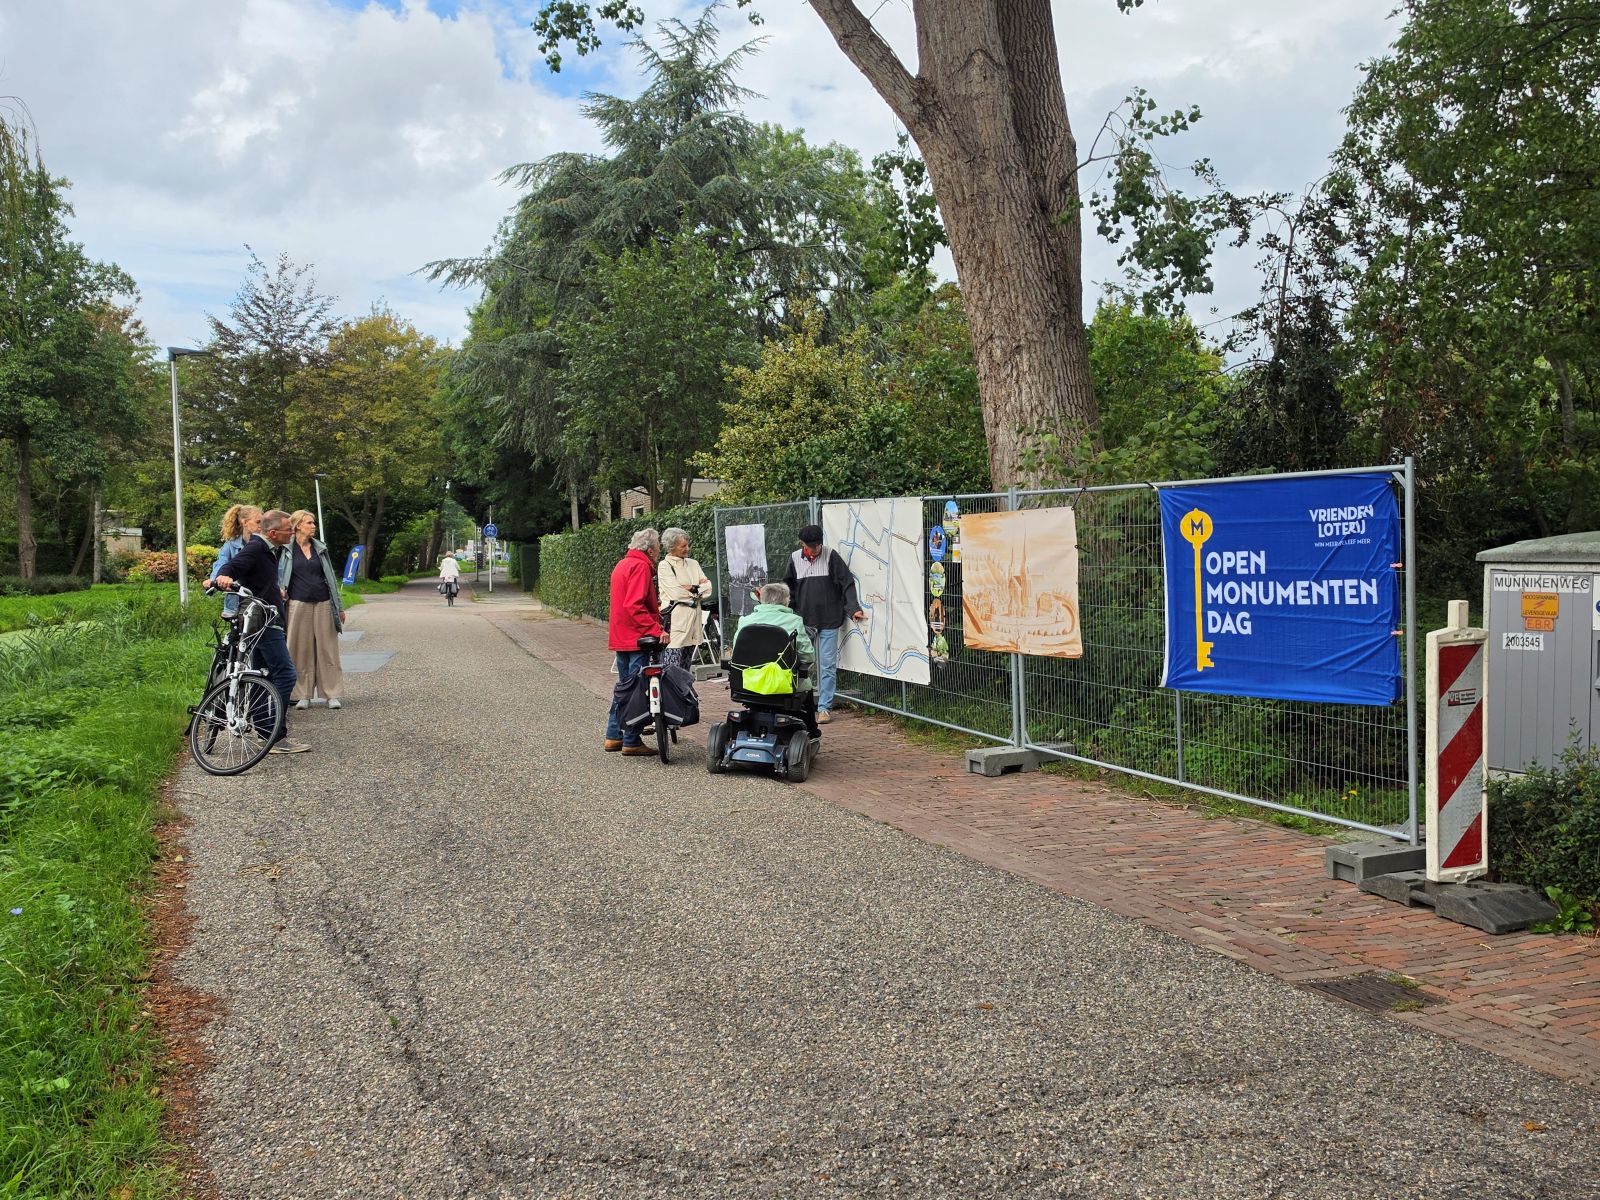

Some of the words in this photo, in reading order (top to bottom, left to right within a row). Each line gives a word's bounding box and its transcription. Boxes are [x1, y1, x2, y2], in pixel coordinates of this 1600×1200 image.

[1309, 504, 1374, 522] VRIENDEN
[1190, 518, 1204, 536] M
[1317, 520, 1366, 538] LOTERIJ
[1205, 550, 1266, 575] OPEN
[1206, 578, 1378, 605] MONUMENTEN
[1494, 576, 1590, 590] MUNNIKENWEG
[1207, 611, 1252, 635] DAG
[1505, 636, 1541, 648] 2003545
